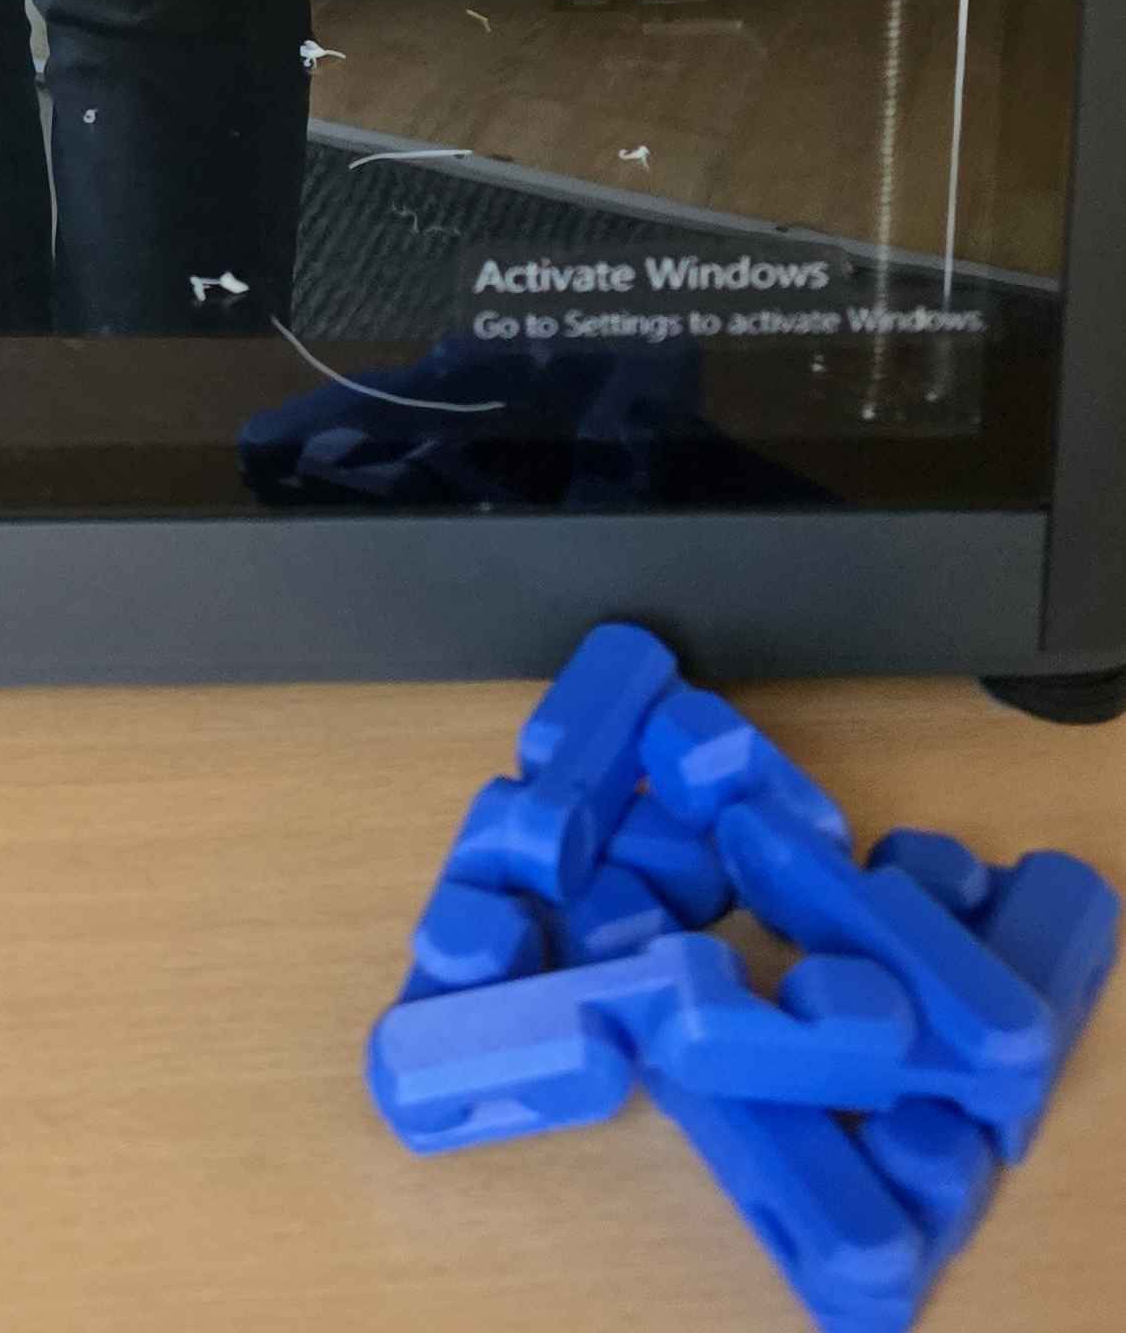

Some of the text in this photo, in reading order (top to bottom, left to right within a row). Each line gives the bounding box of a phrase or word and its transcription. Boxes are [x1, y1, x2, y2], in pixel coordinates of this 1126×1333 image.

[473, 254, 830, 294] Activate Windows
[473, 309, 520, 339] Go
[526, 311, 559, 338] to
[564, 308, 682, 343] Settings
[688, 310, 720, 335] to
[727, 308, 842, 334] activate
